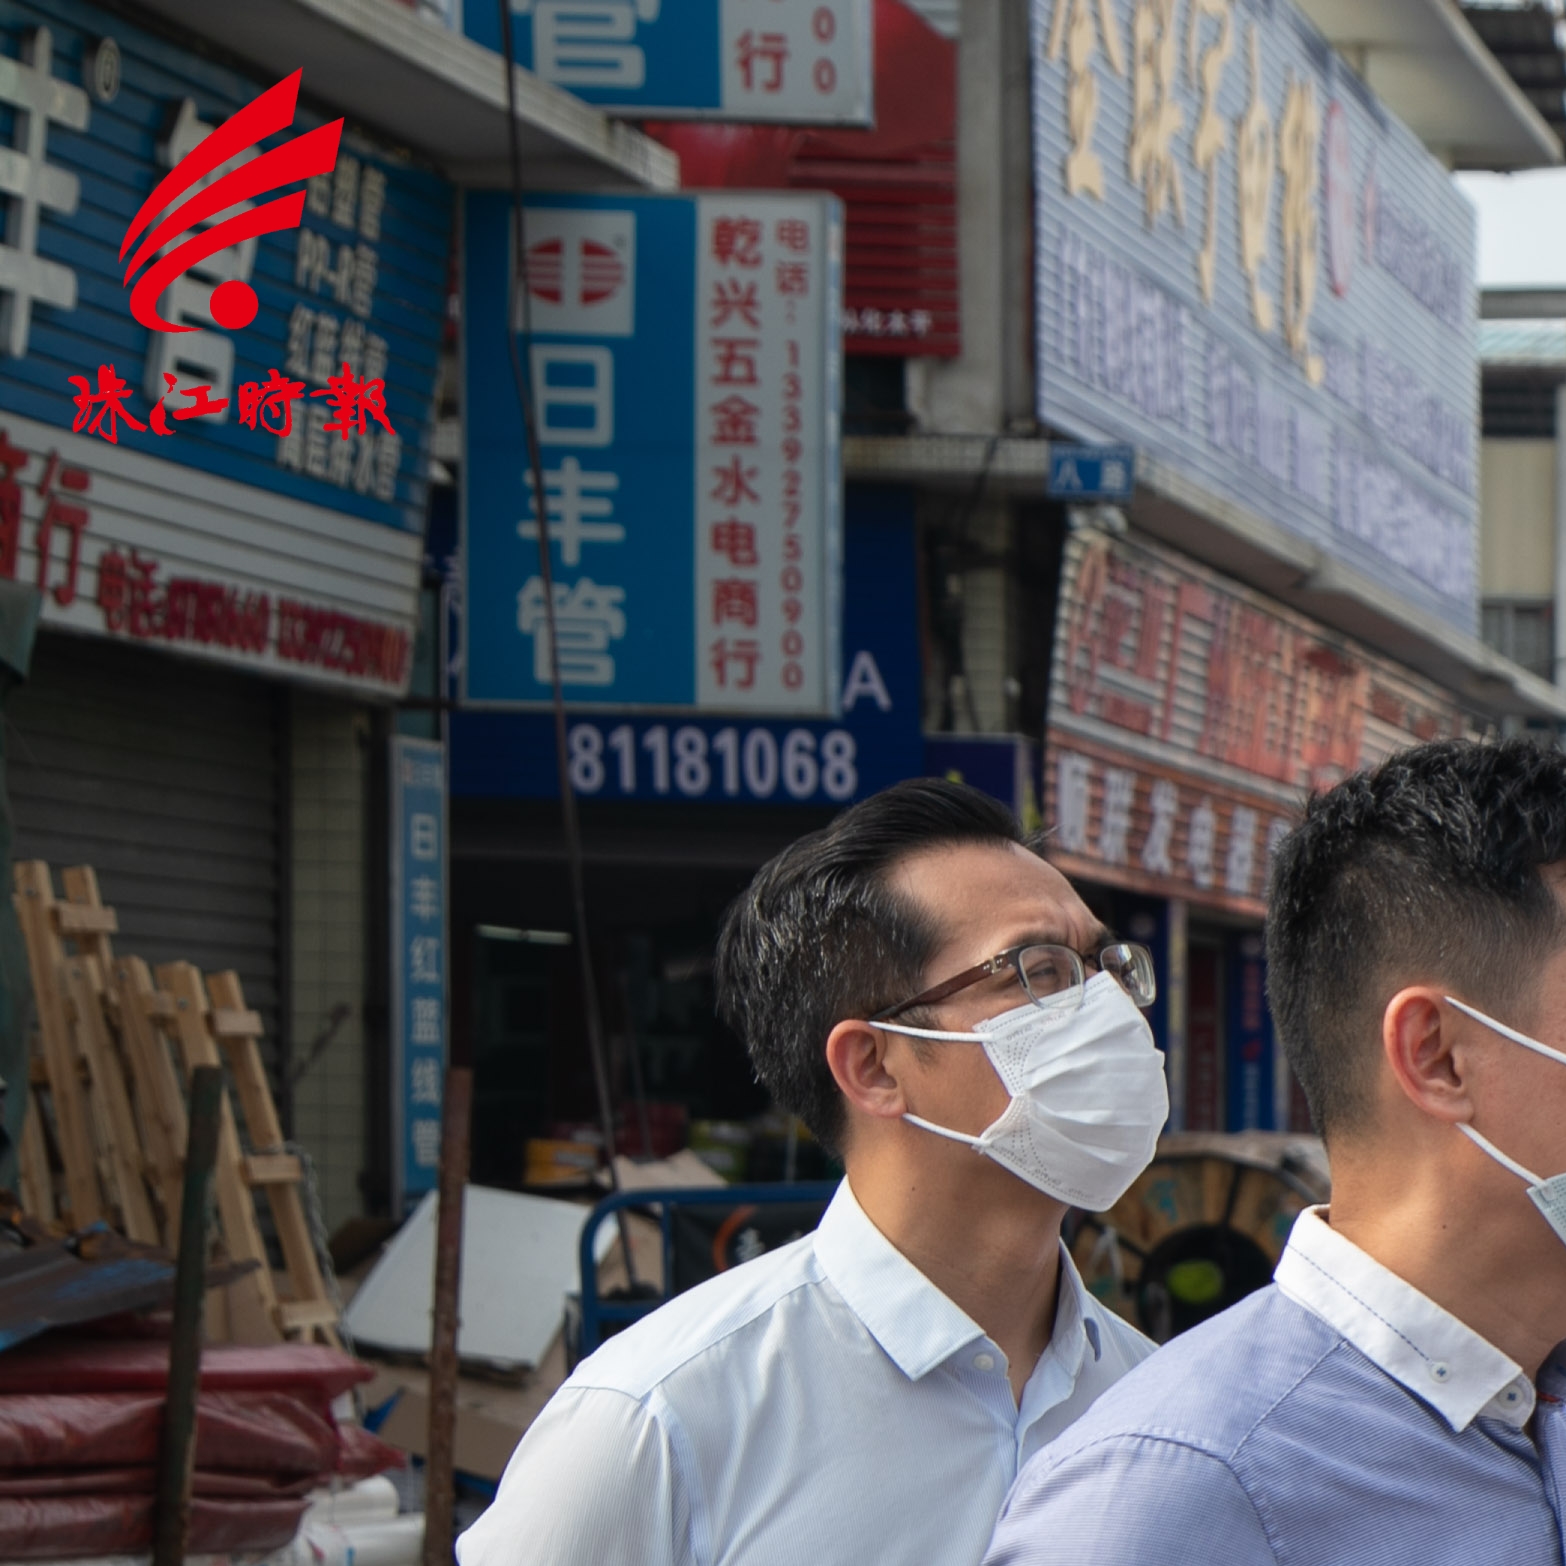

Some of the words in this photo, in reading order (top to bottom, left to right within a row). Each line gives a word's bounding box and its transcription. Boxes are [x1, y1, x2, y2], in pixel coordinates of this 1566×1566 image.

[516, 344, 626, 688] 日丰管
[707, 216, 764, 693] 乾兴五金水电商行
[569, 724, 860, 797] 81181068
